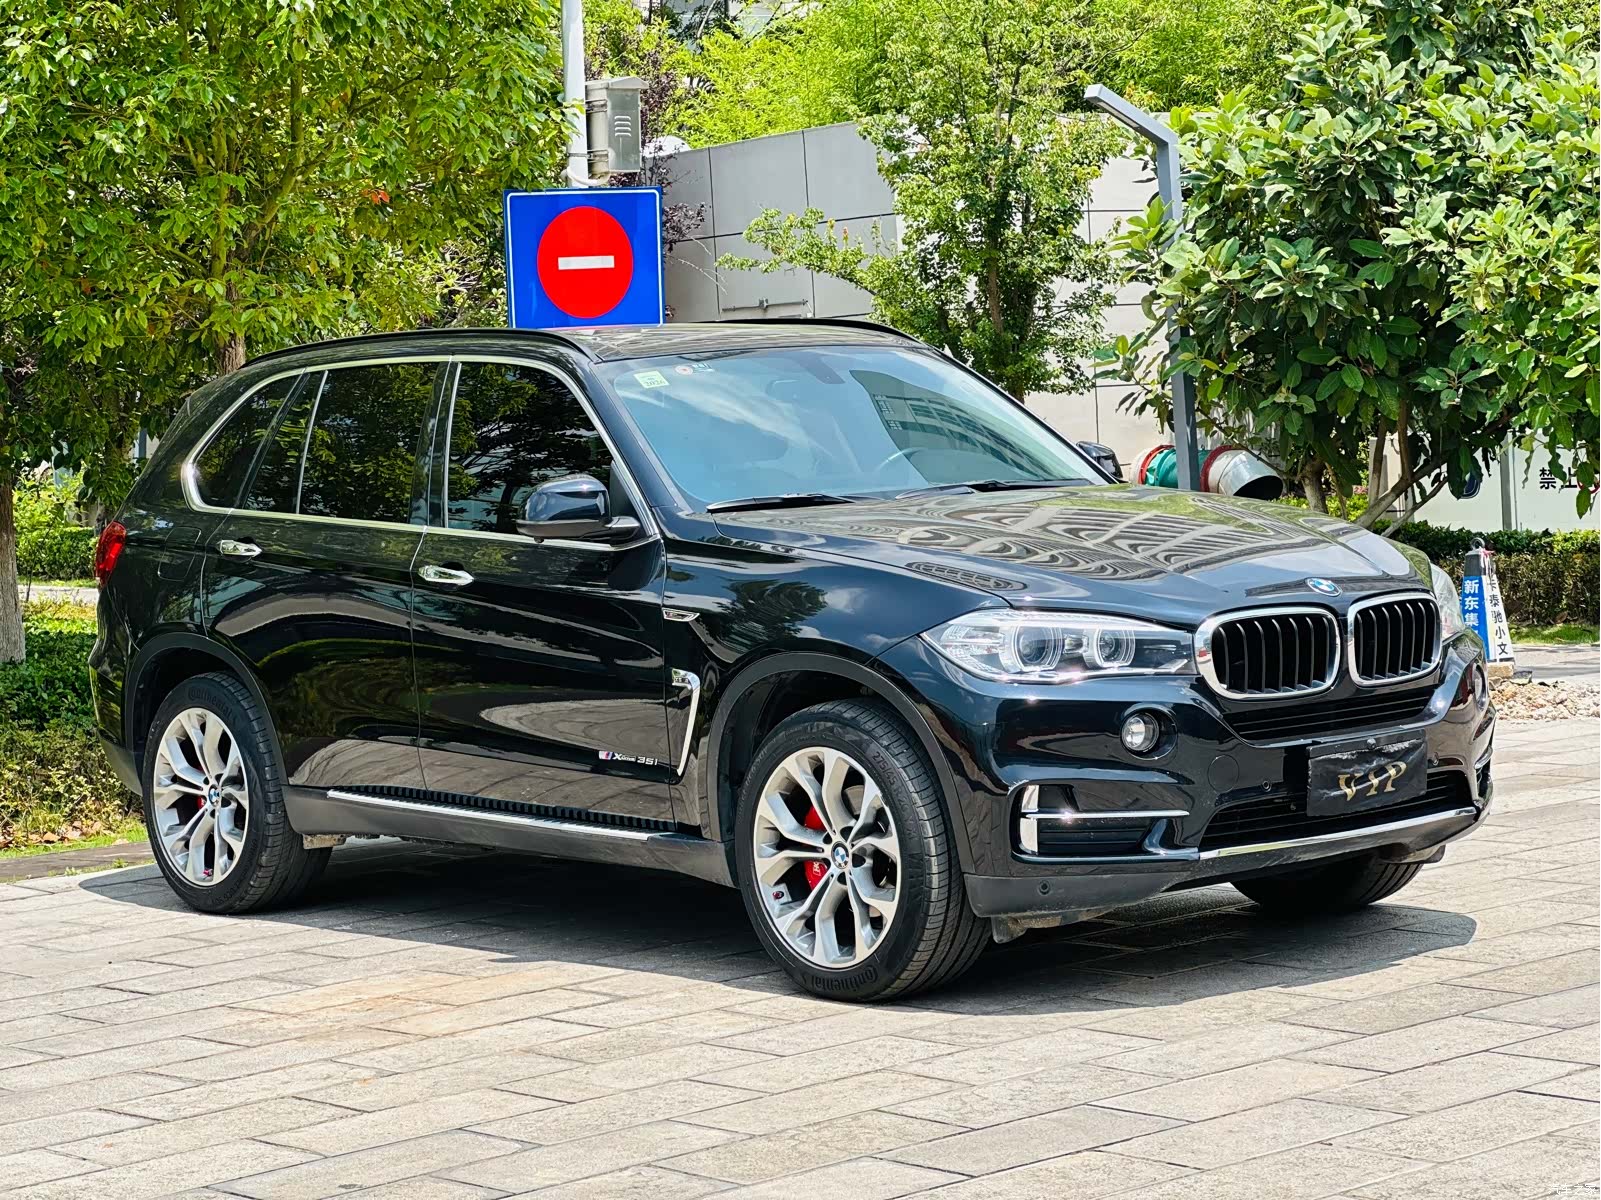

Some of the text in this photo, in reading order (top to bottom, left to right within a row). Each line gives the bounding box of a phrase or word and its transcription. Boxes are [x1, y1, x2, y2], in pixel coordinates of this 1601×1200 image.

[1464, 579, 1479, 635] 新东集
[1338, 761, 1407, 801] VIP
